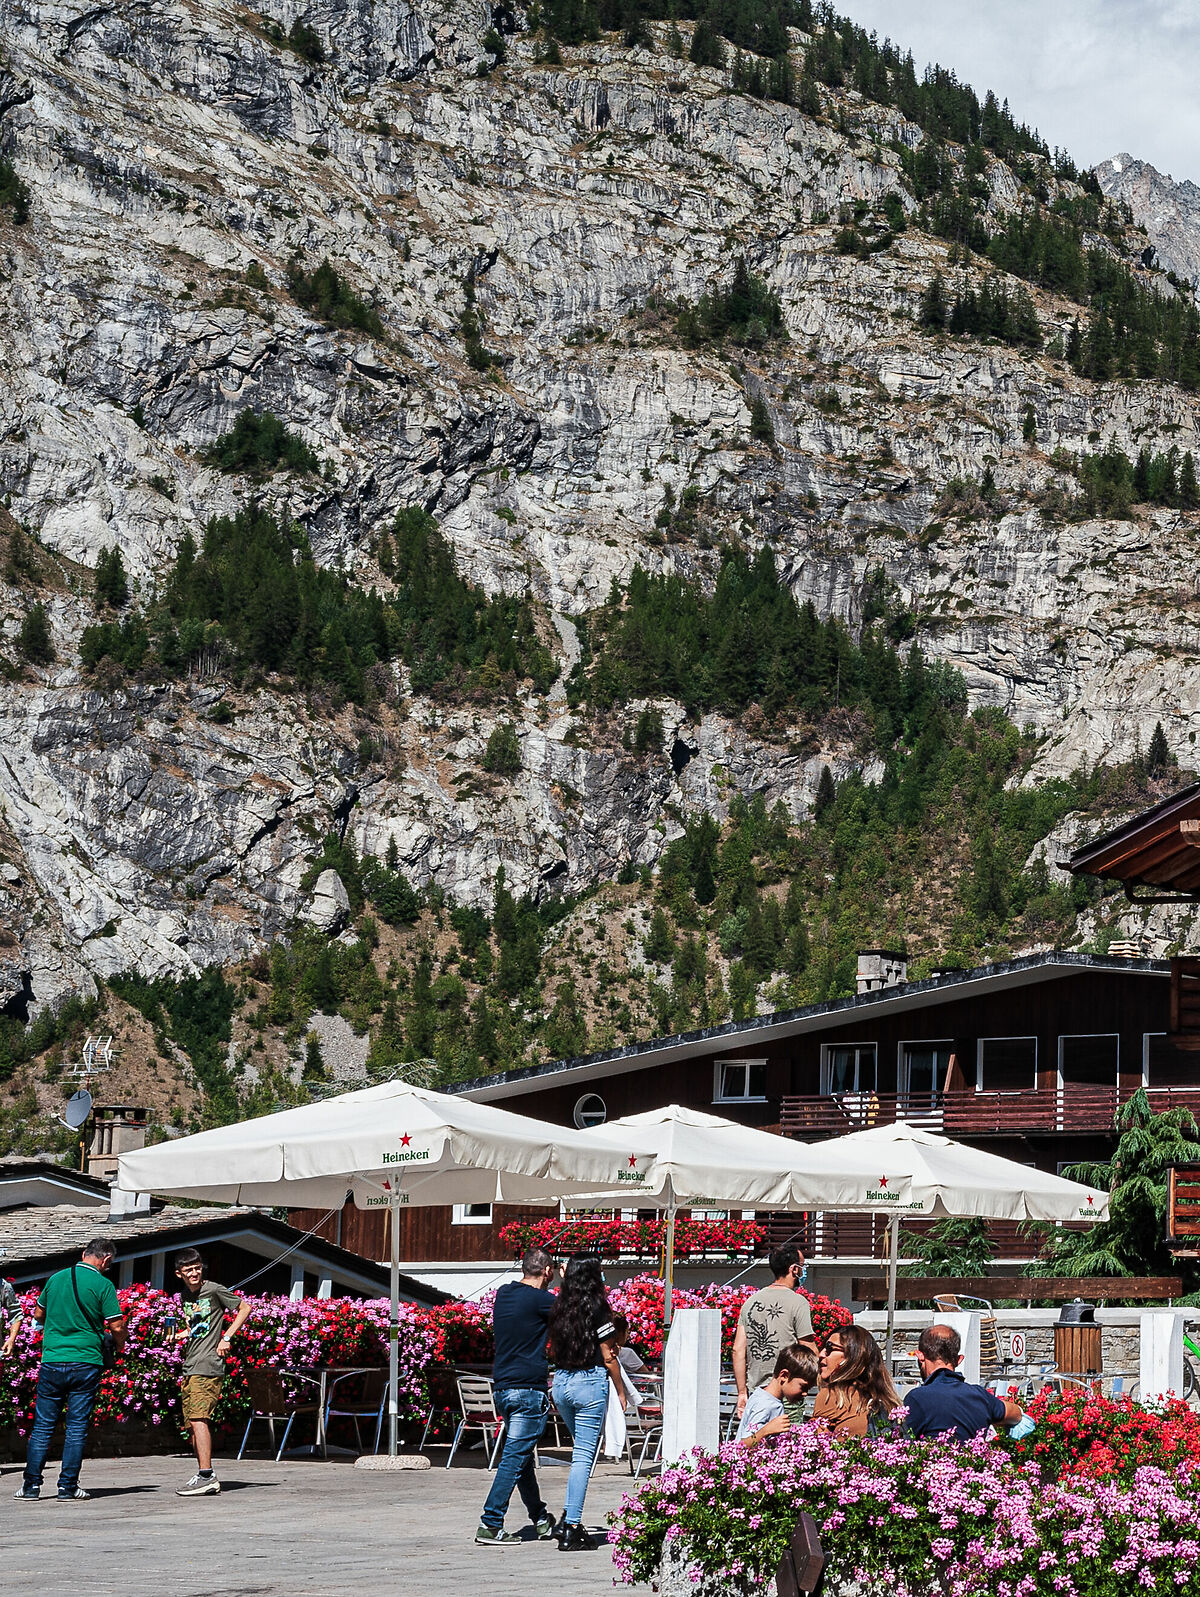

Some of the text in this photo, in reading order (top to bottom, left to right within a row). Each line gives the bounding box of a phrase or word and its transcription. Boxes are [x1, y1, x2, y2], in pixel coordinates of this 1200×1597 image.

[382, 1150, 429, 1163] Heineken
[617, 1170, 646, 1181] Heineken
[866, 1190, 900, 1201] Heineken
